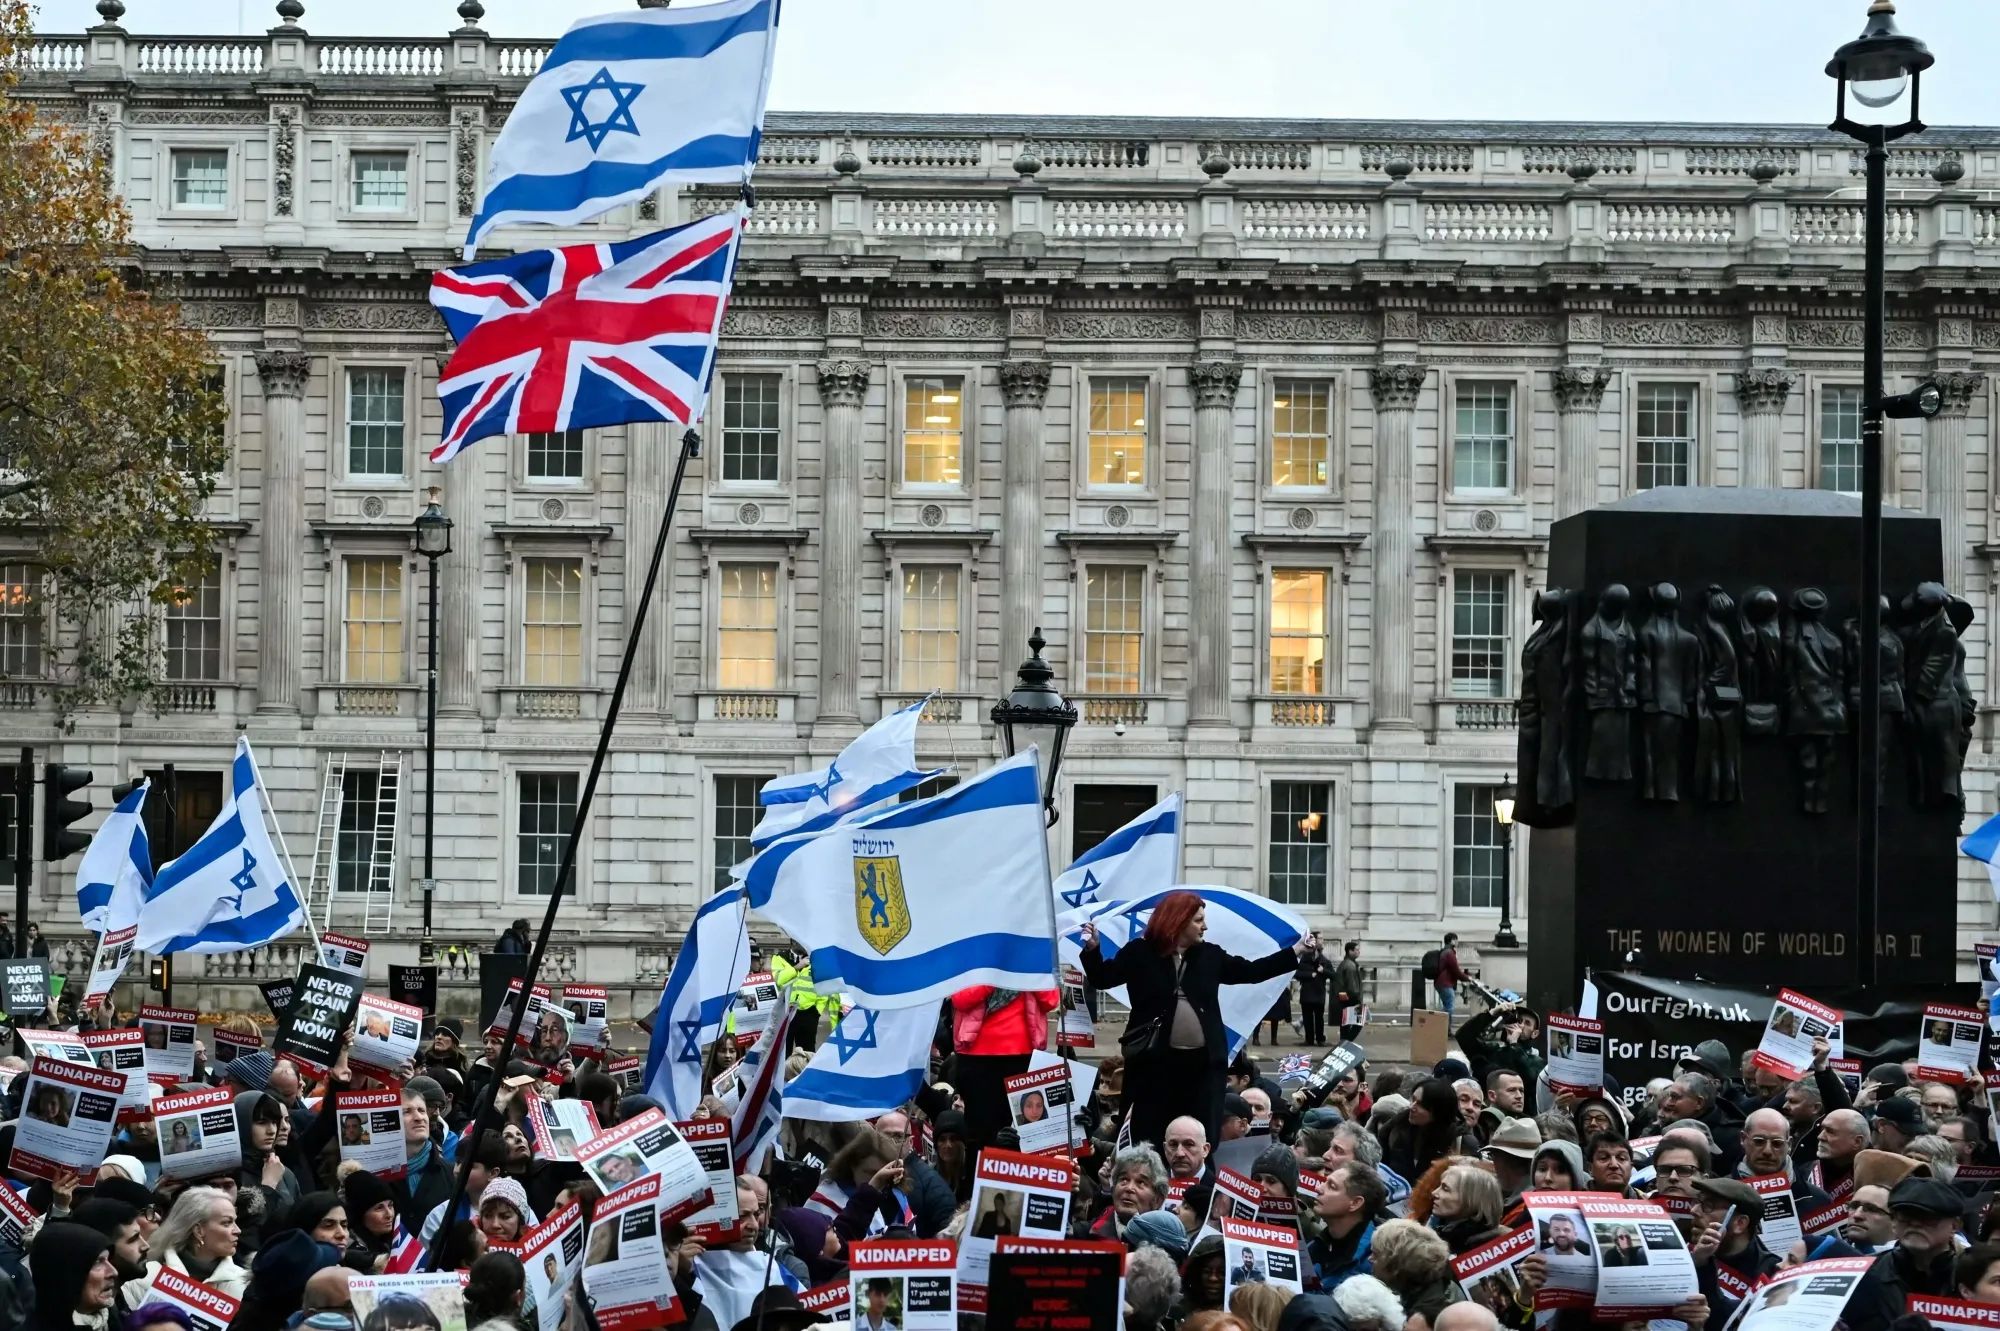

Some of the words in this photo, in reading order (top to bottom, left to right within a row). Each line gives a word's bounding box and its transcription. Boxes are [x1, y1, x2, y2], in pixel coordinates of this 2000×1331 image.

[852, 833, 895, 855] ירושלים
[106, 926, 138, 943] KIDNAPPED
[325, 934, 368, 950] KIDNAPPED
[1607, 929, 1642, 951] THE
[1658, 930, 1730, 954] WOMEN
[1743, 932, 1766, 955] OF
[1778, 933, 1846, 956] WORLD
[1873, 934, 1896, 956] AR
[1910, 935, 1922, 957] II
[7, 965, 42, 975] NEVER
[8, 975, 44, 984] AGAIN
[307, 976, 354, 999] NEVER
[512, 980, 550, 996] KIDAPPED
[22, 985, 32, 993] IS
[267, 987, 293, 998] NEVER
[566, 987, 606, 997] KIDNAPPED
[12, 994, 44, 1003] NOW!
[300, 990, 350, 1013] AGAIN
[362, 995, 419, 1016] KIDNAPPED
[1606, 992, 1751, 1023] OurFight.uk
[1782, 992, 1836, 1022] KIDNAPPED
[142, 1008, 196, 1021] KIDNAPPED
[312, 1008, 328, 1022] IS
[1927, 1005, 1983, 1020] KIDNAPPED
[293, 1019, 337, 1042] NOW!
[1550, 1016, 1602, 1030] KIDNAPPED
[23, 1031, 79, 1042] KIDNAPPED
[216, 1030, 259, 1044] KIDNAPPED
[1332, 1046, 1356, 1065] NEVER
[1608, 1038, 1643, 1059] For
[608, 1058, 639, 1070] KIDNAPPED
[1319, 1066, 1330, 1076] IS
[1323, 1055, 1349, 1073] AGAIN
[1830, 1061, 1860, 1070] KIDNAPPED
[38, 1061, 122, 1088] KIDNAPPED
[156, 1091, 230, 1112] KIDNAPPED
[339, 1094, 397, 1106] KIDNAPPED
[533, 1098, 554, 1157] KIDNAPPED
[578, 1111, 659, 1158] KIDNAPPED
[983, 1158, 1068, 1184] KIDNAPPED
[1219, 1170, 1261, 1199] KIDNAPPED
[596, 1181, 658, 1216] KIDNAPPED
[1584, 1202, 1665, 1215] KIDNAPPED
[525, 1202, 580, 1254] KIDNAPPED
[1227, 1222, 1294, 1244] KIDNAPPED
[855, 1248, 951, 1264] KIDNAPPED
[1457, 1228, 1535, 1274] KIDNAPPED
[1774, 1259, 1868, 1280] KIDNAPPED
[159, 1272, 234, 1316] KIDNAPPED
[910, 1298, 930, 1306] Israeli
